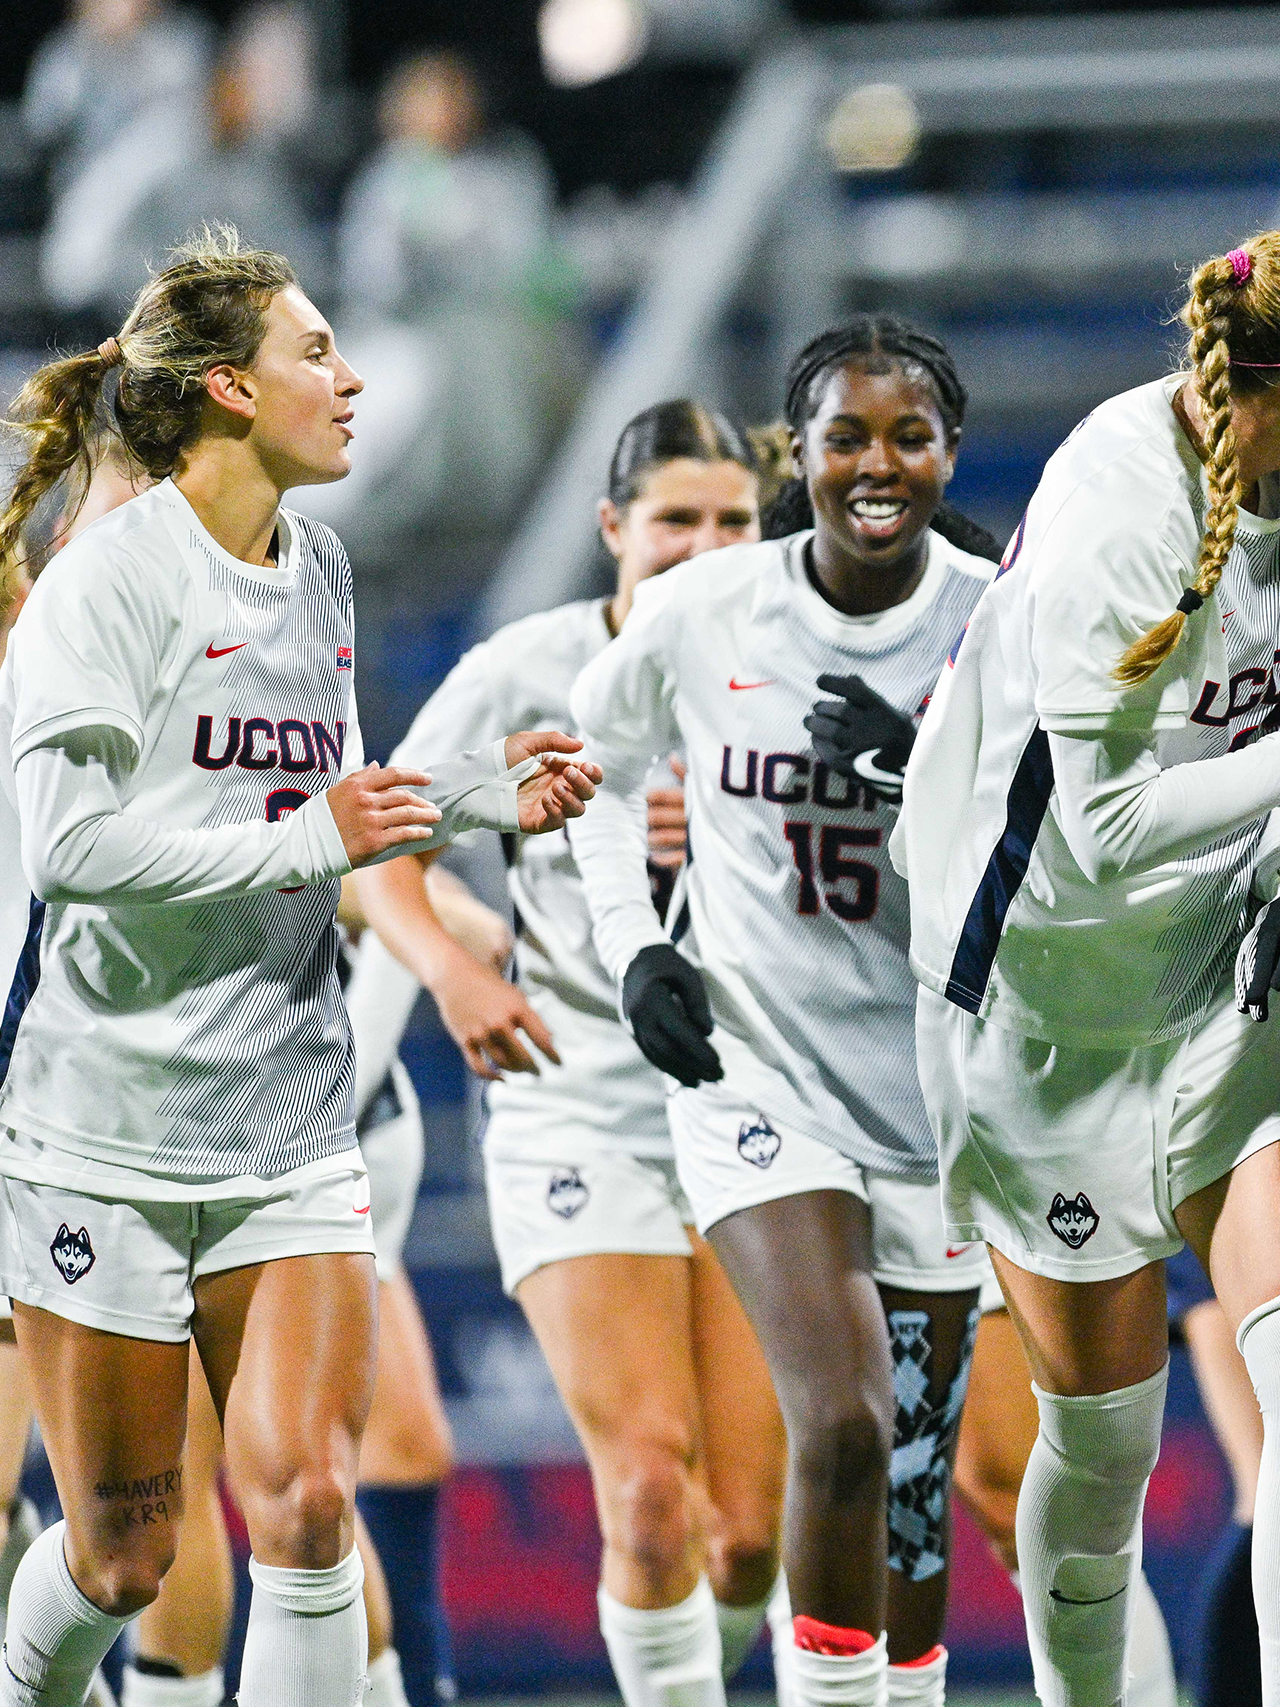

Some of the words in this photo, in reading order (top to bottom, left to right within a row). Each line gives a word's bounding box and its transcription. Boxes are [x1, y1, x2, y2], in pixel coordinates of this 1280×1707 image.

[337, 657, 352, 668] EAS
[193, 715, 347, 774] UCON
[784, 821, 882, 923] 15
